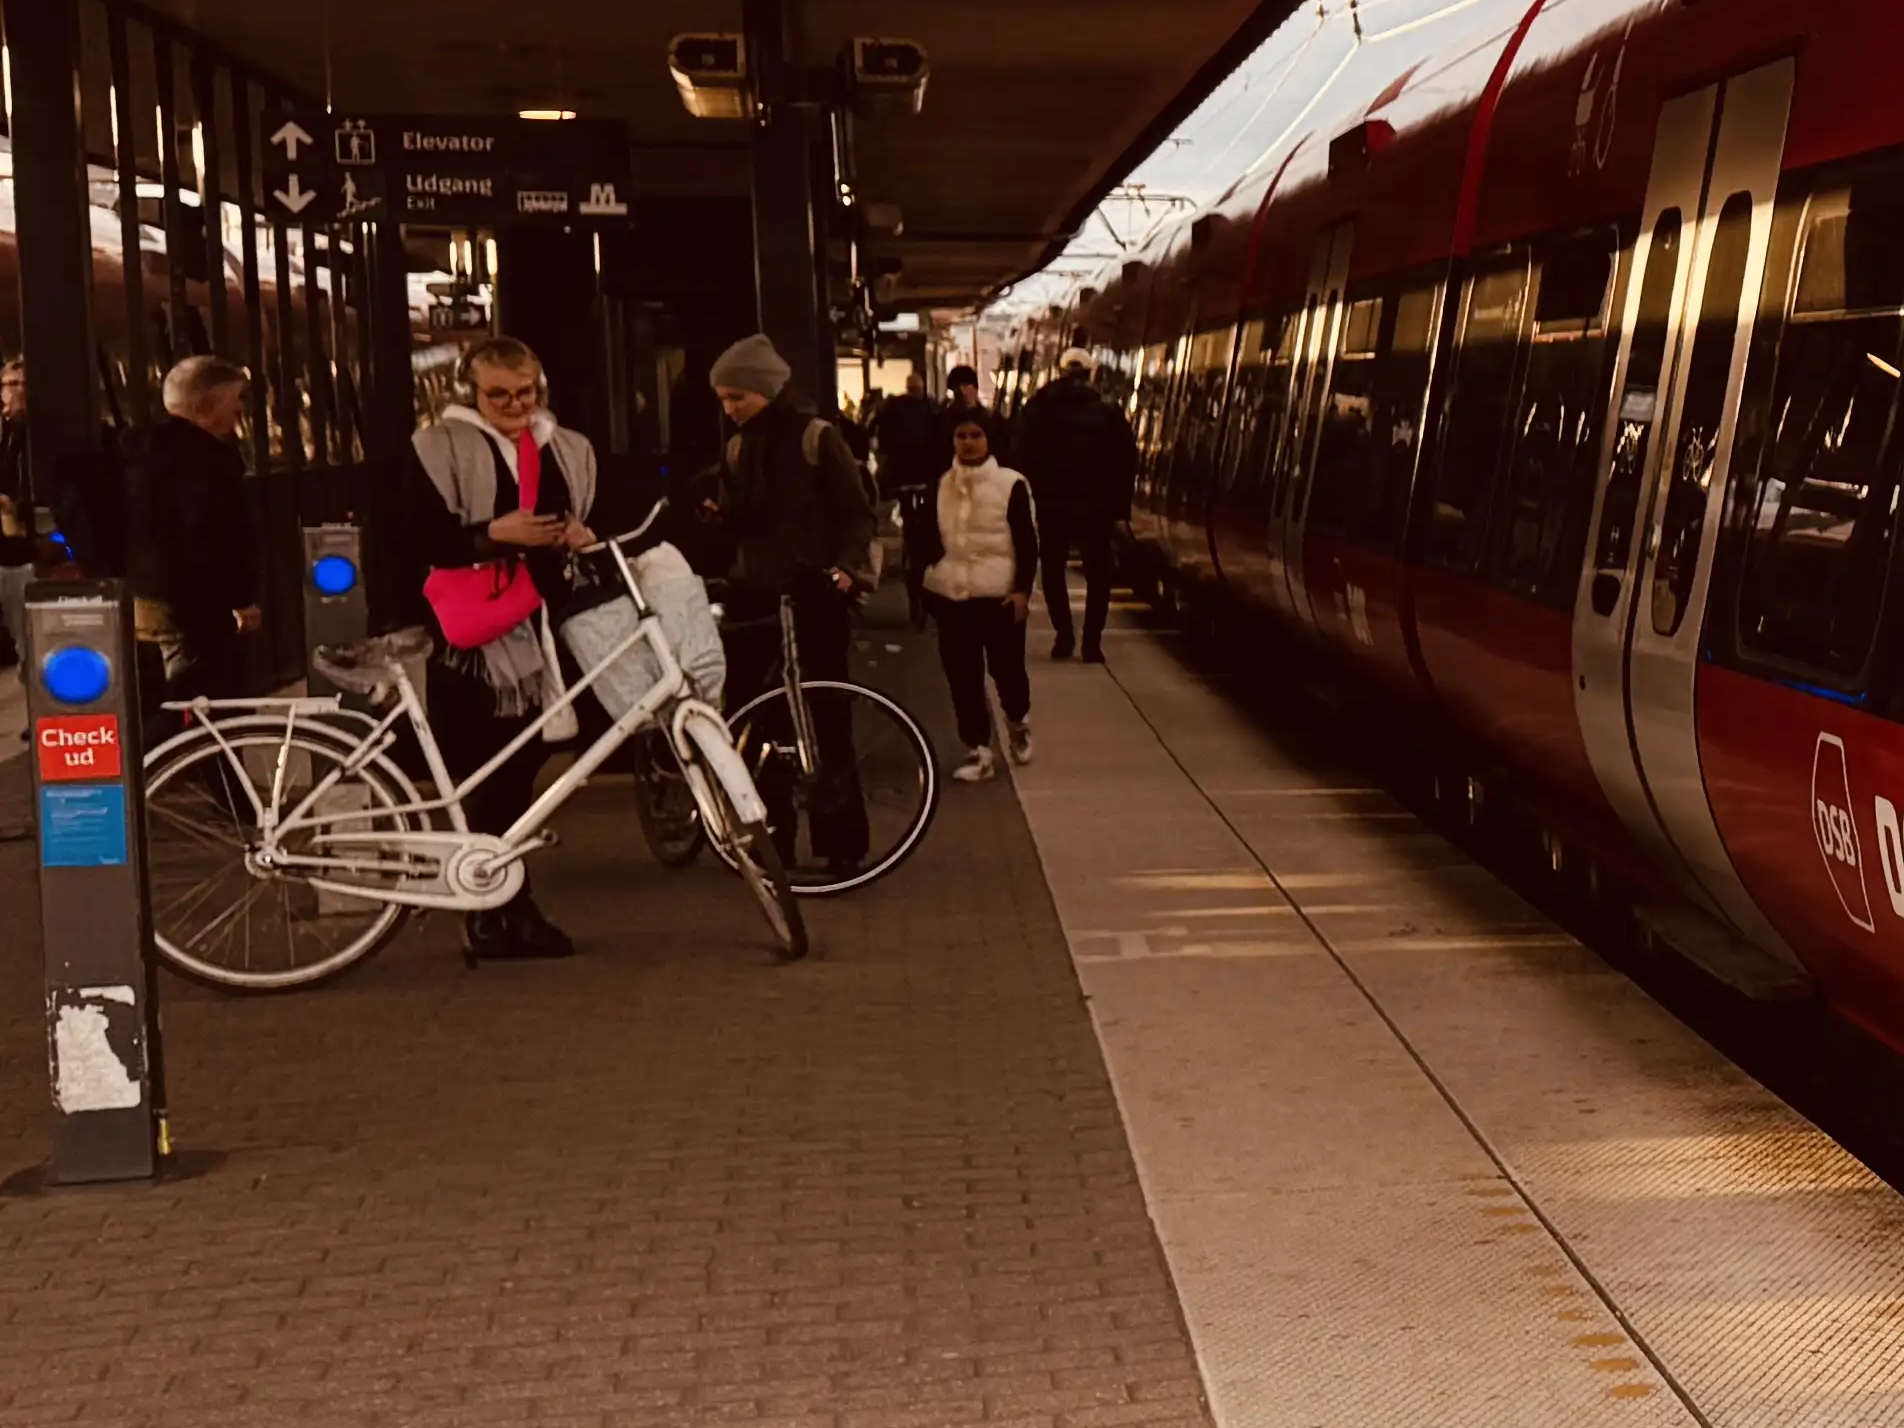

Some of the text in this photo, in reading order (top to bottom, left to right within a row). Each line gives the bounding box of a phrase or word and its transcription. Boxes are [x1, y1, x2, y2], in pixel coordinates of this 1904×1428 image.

[403, 131, 496, 152] Elevator
[406, 174, 493, 197] Udgang
[407, 196, 436, 211] Exit
[41, 726, 115, 747] Check
[64, 747, 95, 766] ud
[1817, 799, 1856, 866] DSB
